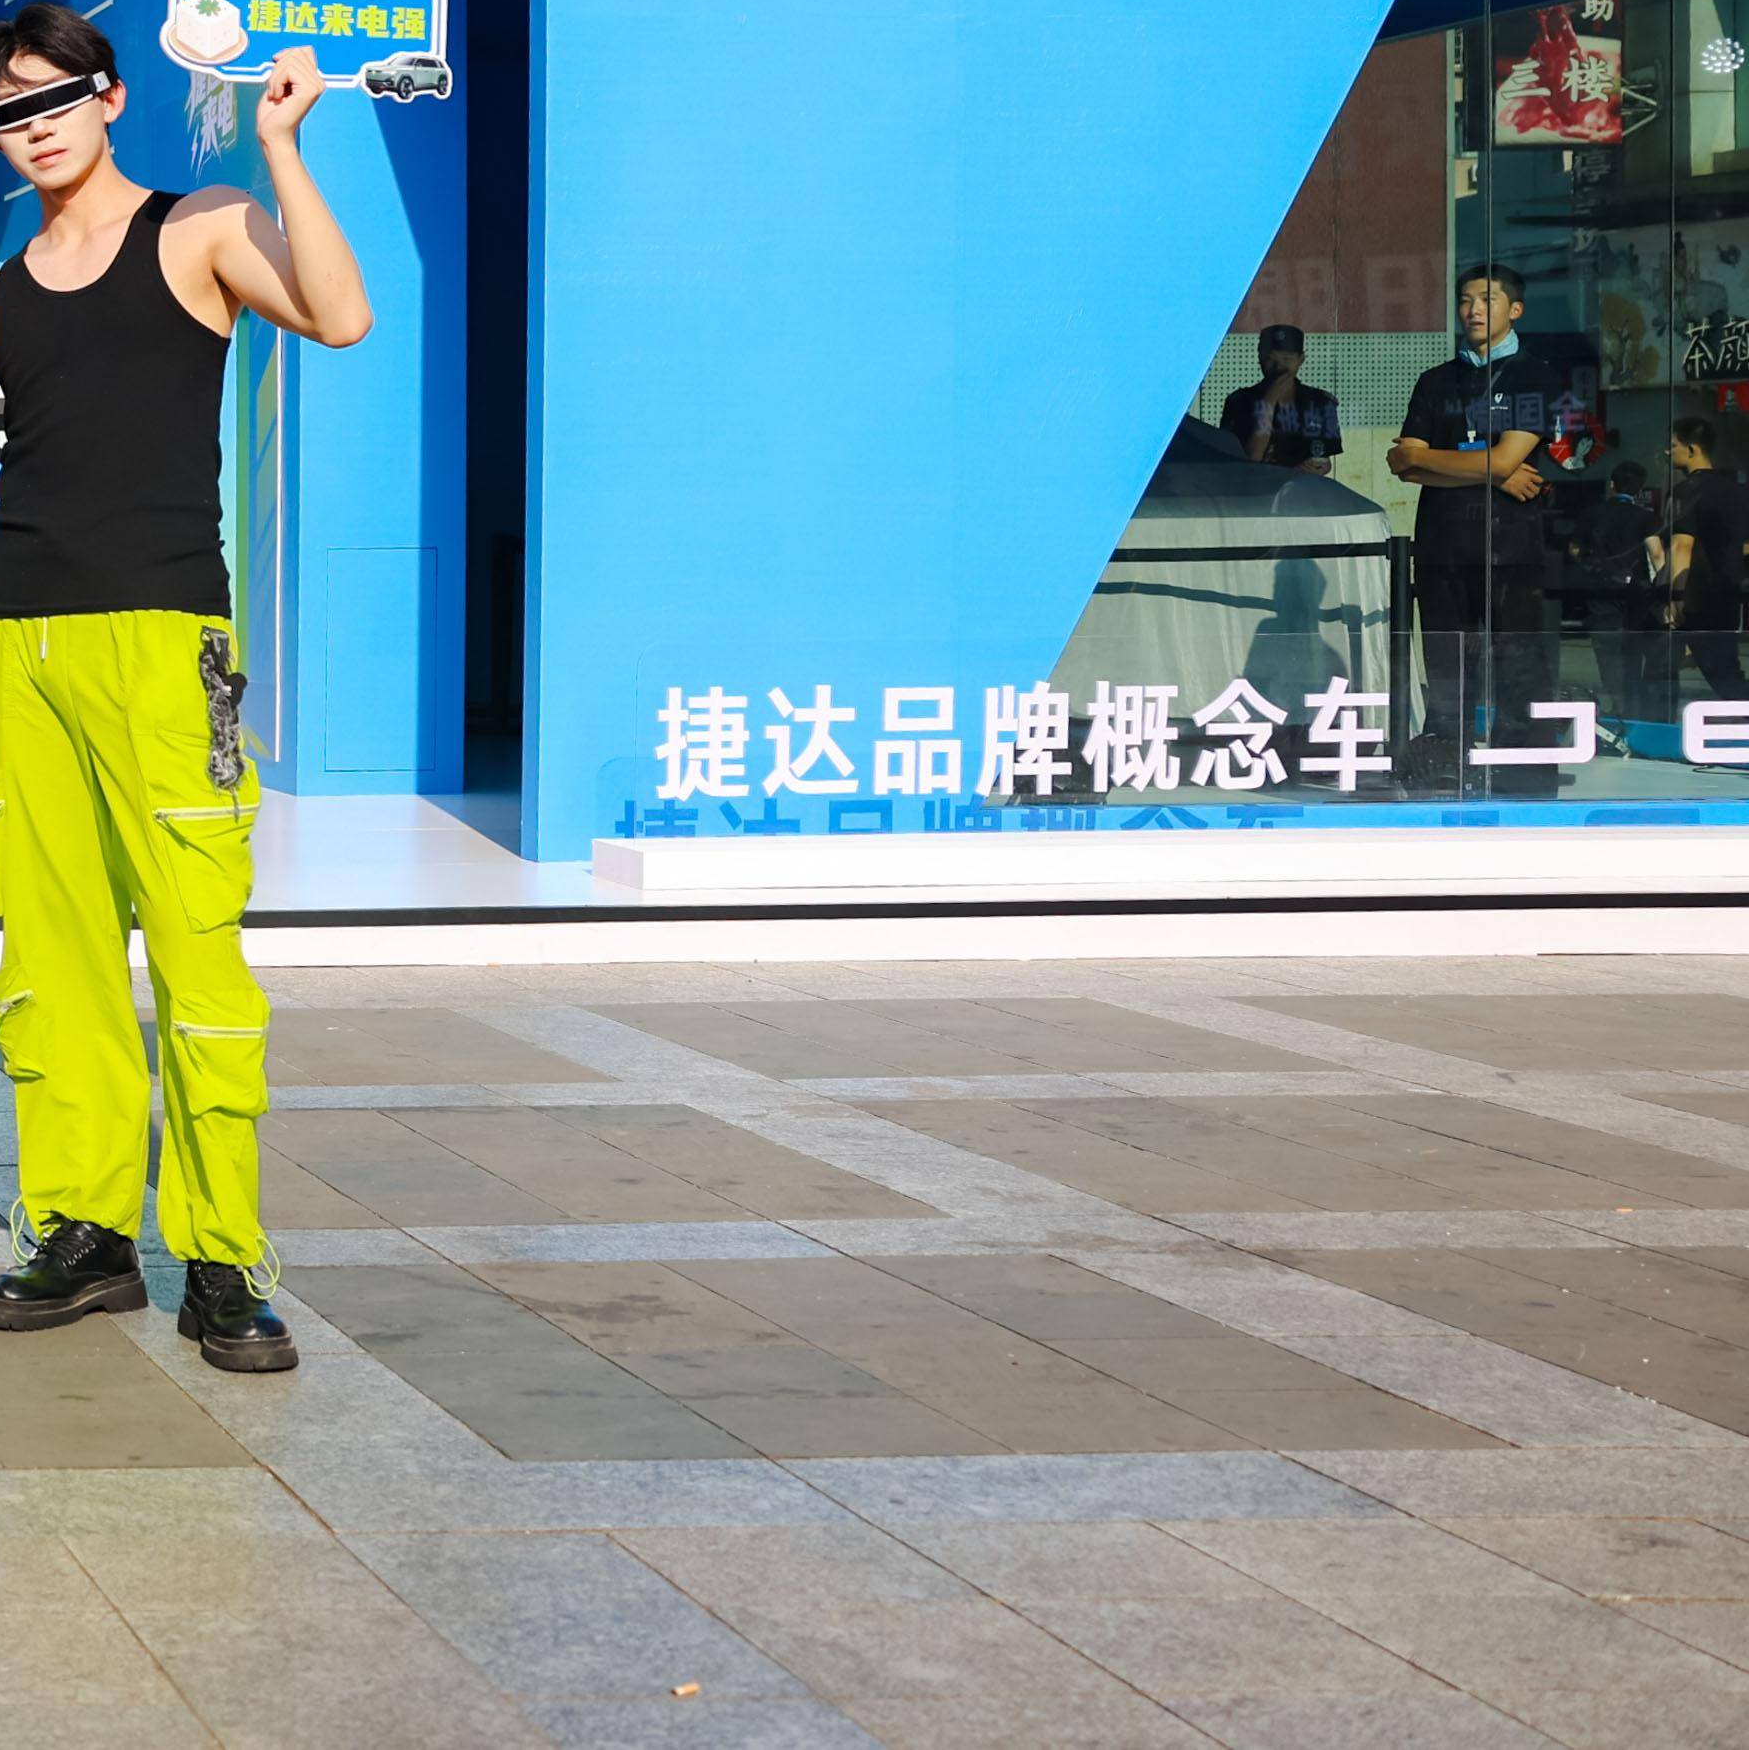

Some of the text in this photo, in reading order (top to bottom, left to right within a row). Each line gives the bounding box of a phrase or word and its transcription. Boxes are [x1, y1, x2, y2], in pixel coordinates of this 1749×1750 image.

[1502, 56, 1615, 104] 三楼
[654, 676, 1393, 802] 捷达品牌概念车
